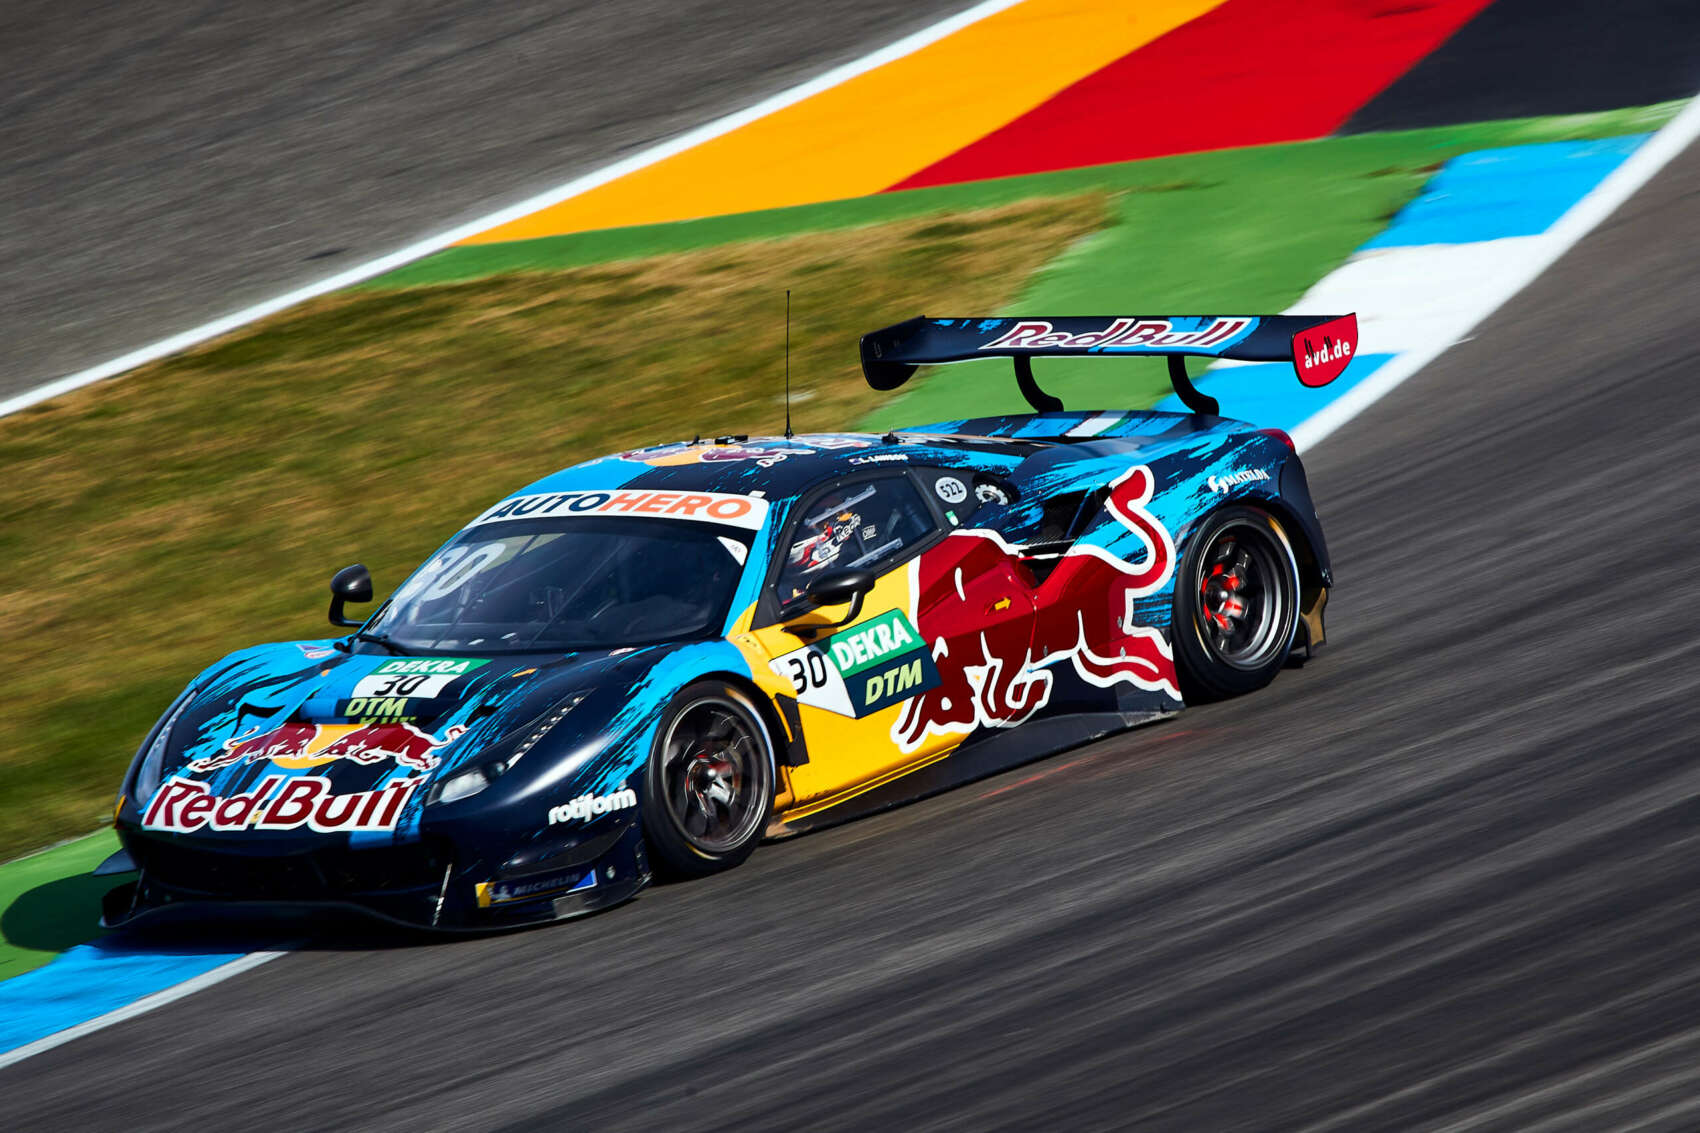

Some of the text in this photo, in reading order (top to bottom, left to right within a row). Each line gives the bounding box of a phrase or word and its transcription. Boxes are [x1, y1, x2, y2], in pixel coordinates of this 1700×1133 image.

[1003, 319, 1248, 348] Red Bull
[1304, 338, 1351, 369] avd.de
[939, 481, 963, 498] 522
[481, 492, 752, 520] AUTOHERO
[831, 617, 913, 672] DEKRA
[377, 660, 471, 674] DEKRA
[788, 650, 828, 696] 30
[864, 657, 923, 706] DTM
[373, 674, 431, 696] 30
[343, 697, 409, 717] DTM
[142, 776, 425, 830] Red Bull
[548, 787, 638, 826] rotiform
